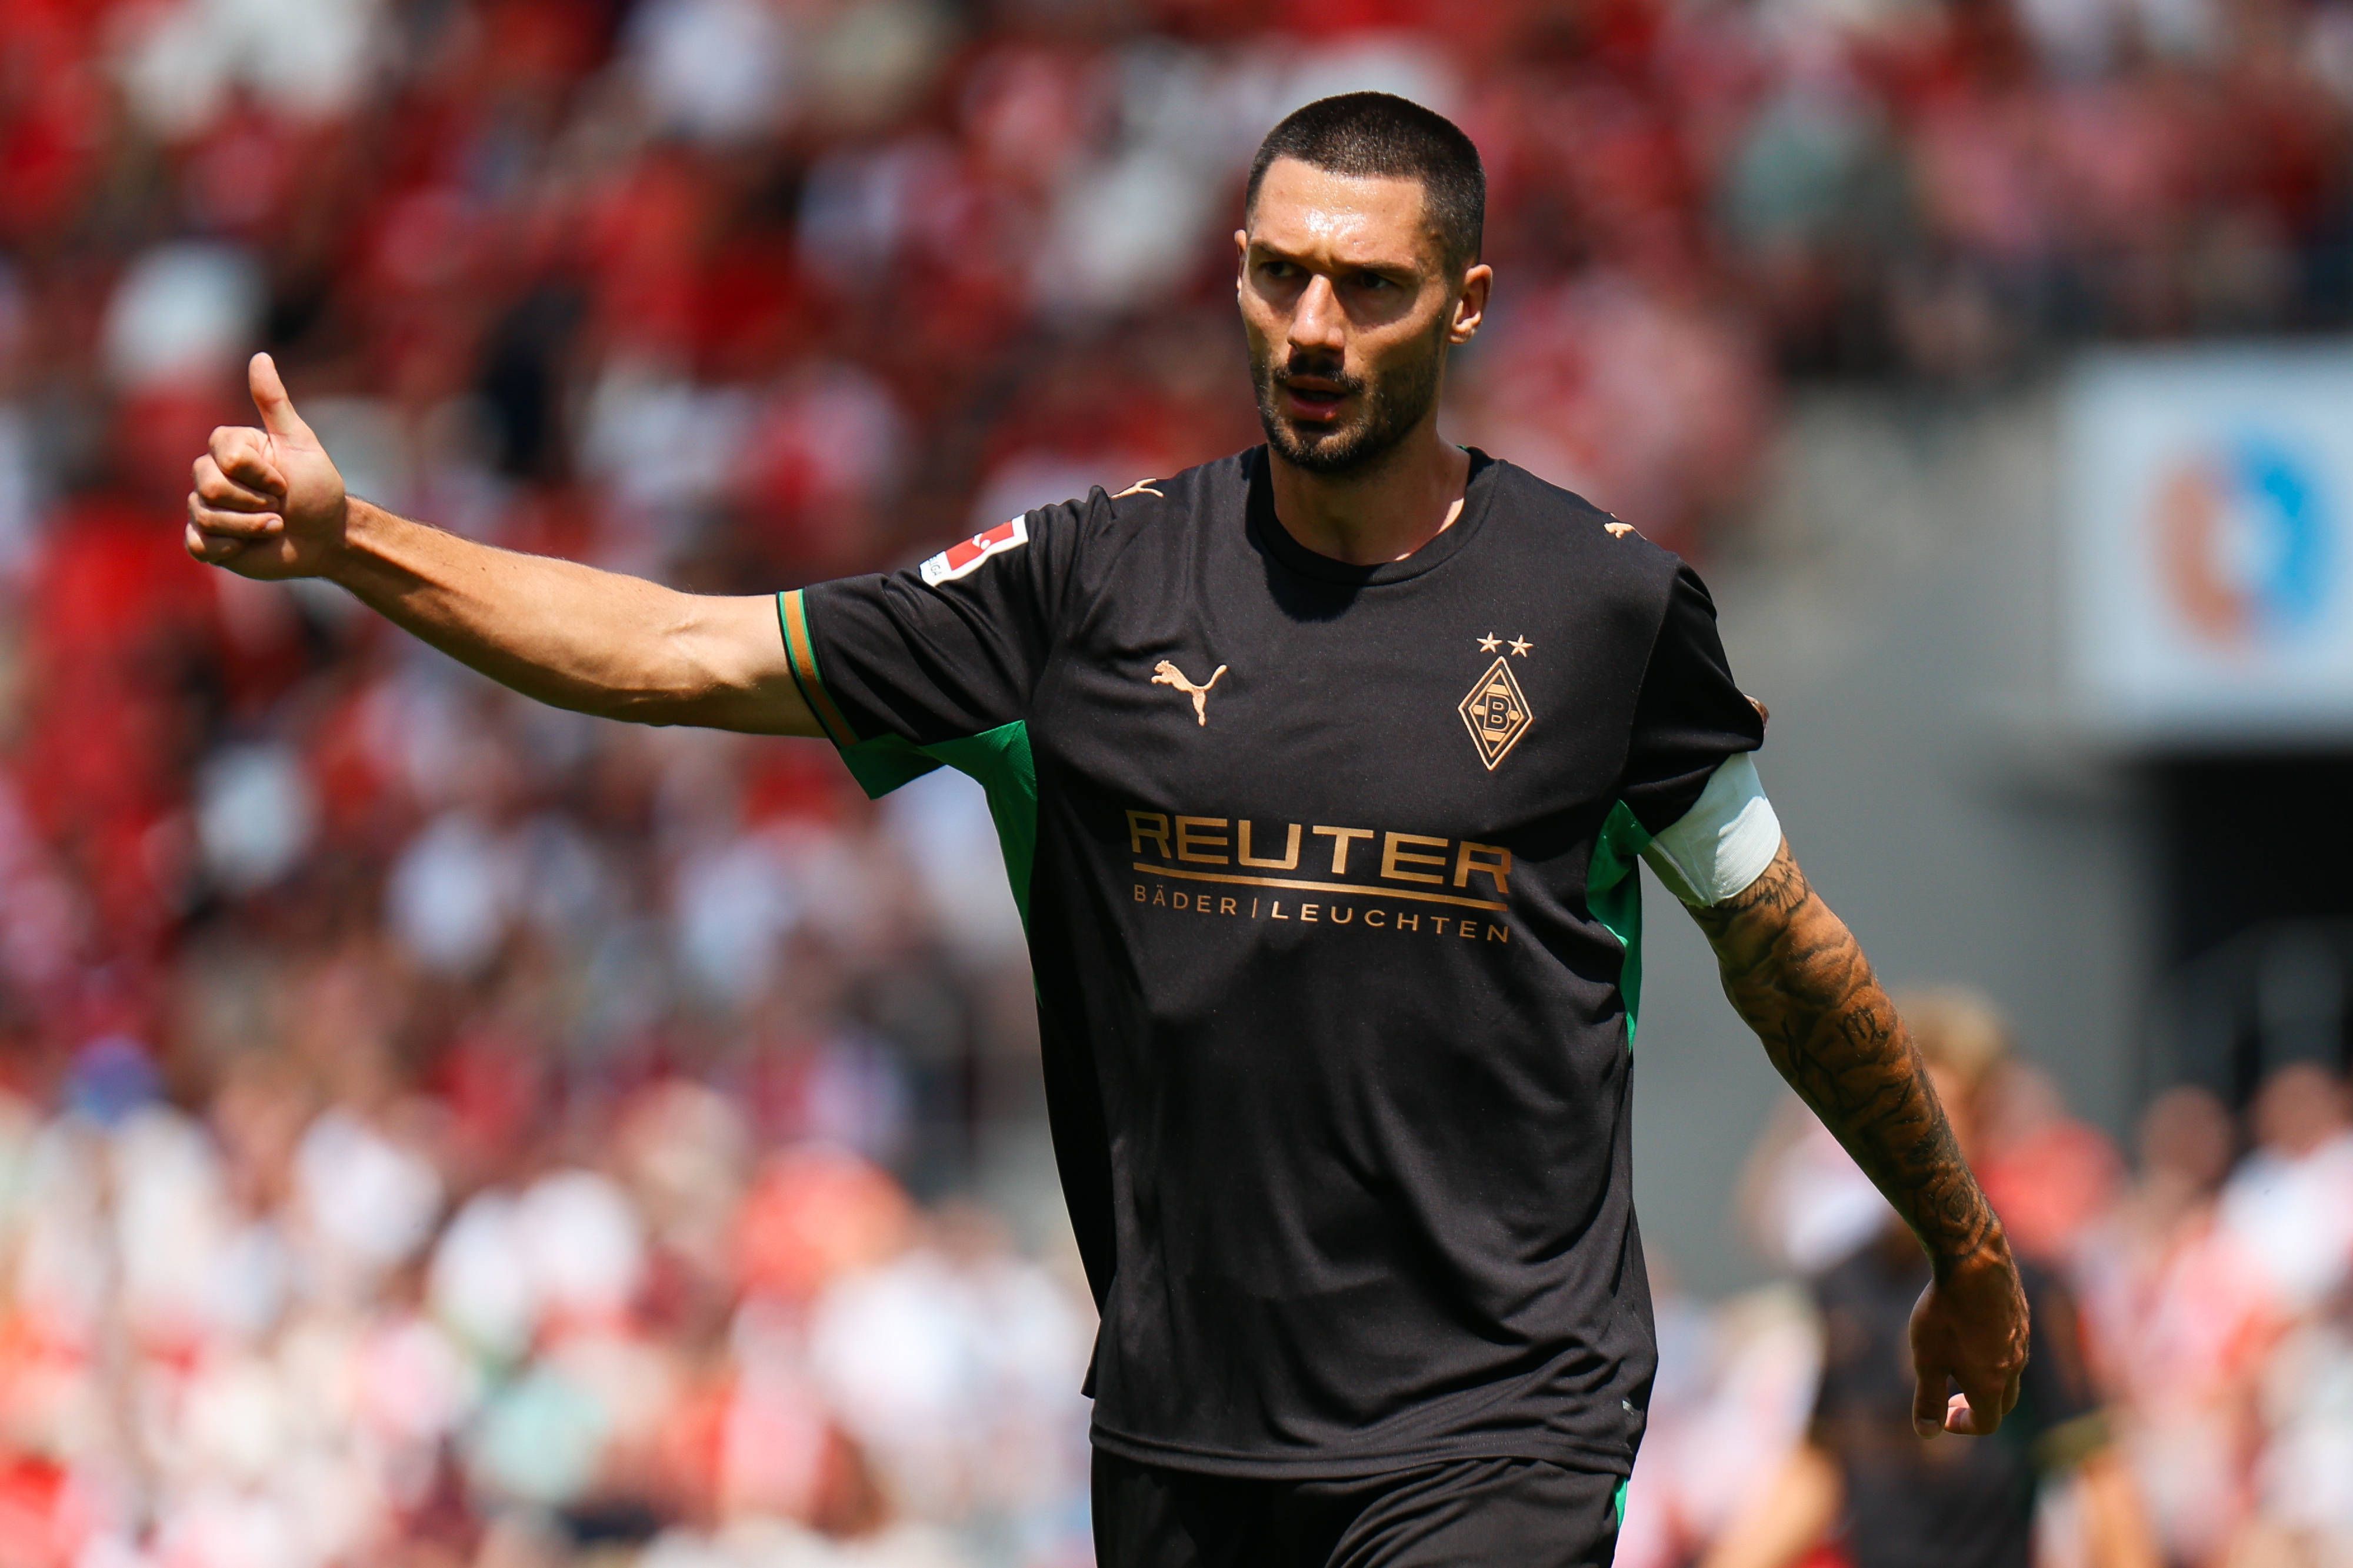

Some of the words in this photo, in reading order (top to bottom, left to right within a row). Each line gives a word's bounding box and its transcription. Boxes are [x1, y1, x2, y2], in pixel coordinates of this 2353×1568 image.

[1484, 693, 1511, 732] B
[1126, 810, 1511, 893] REUTER
[1134, 883, 1236, 915] BÄDER
[1271, 900, 1509, 943] LEUCHTEN
